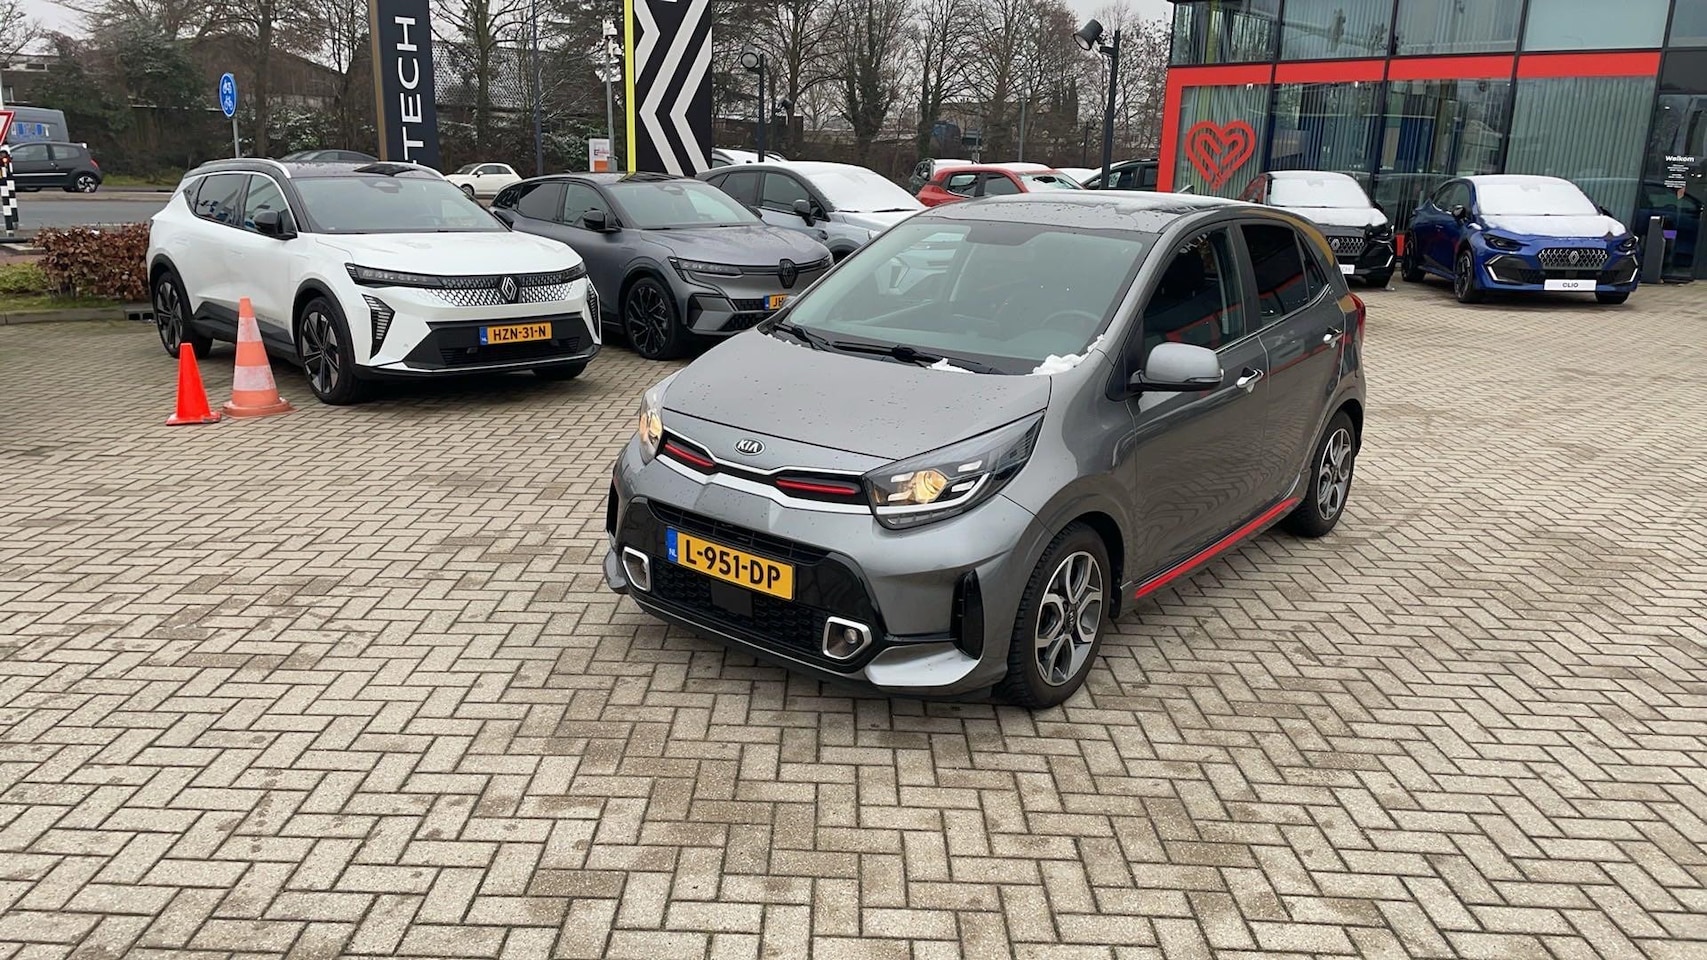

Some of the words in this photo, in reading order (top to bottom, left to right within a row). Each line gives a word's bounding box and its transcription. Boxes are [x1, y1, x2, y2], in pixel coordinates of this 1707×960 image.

[493, 326, 546, 341] HZN-31-N
[737, 439, 758, 453] KIA
[686, 539, 781, 589] L-951-DP
